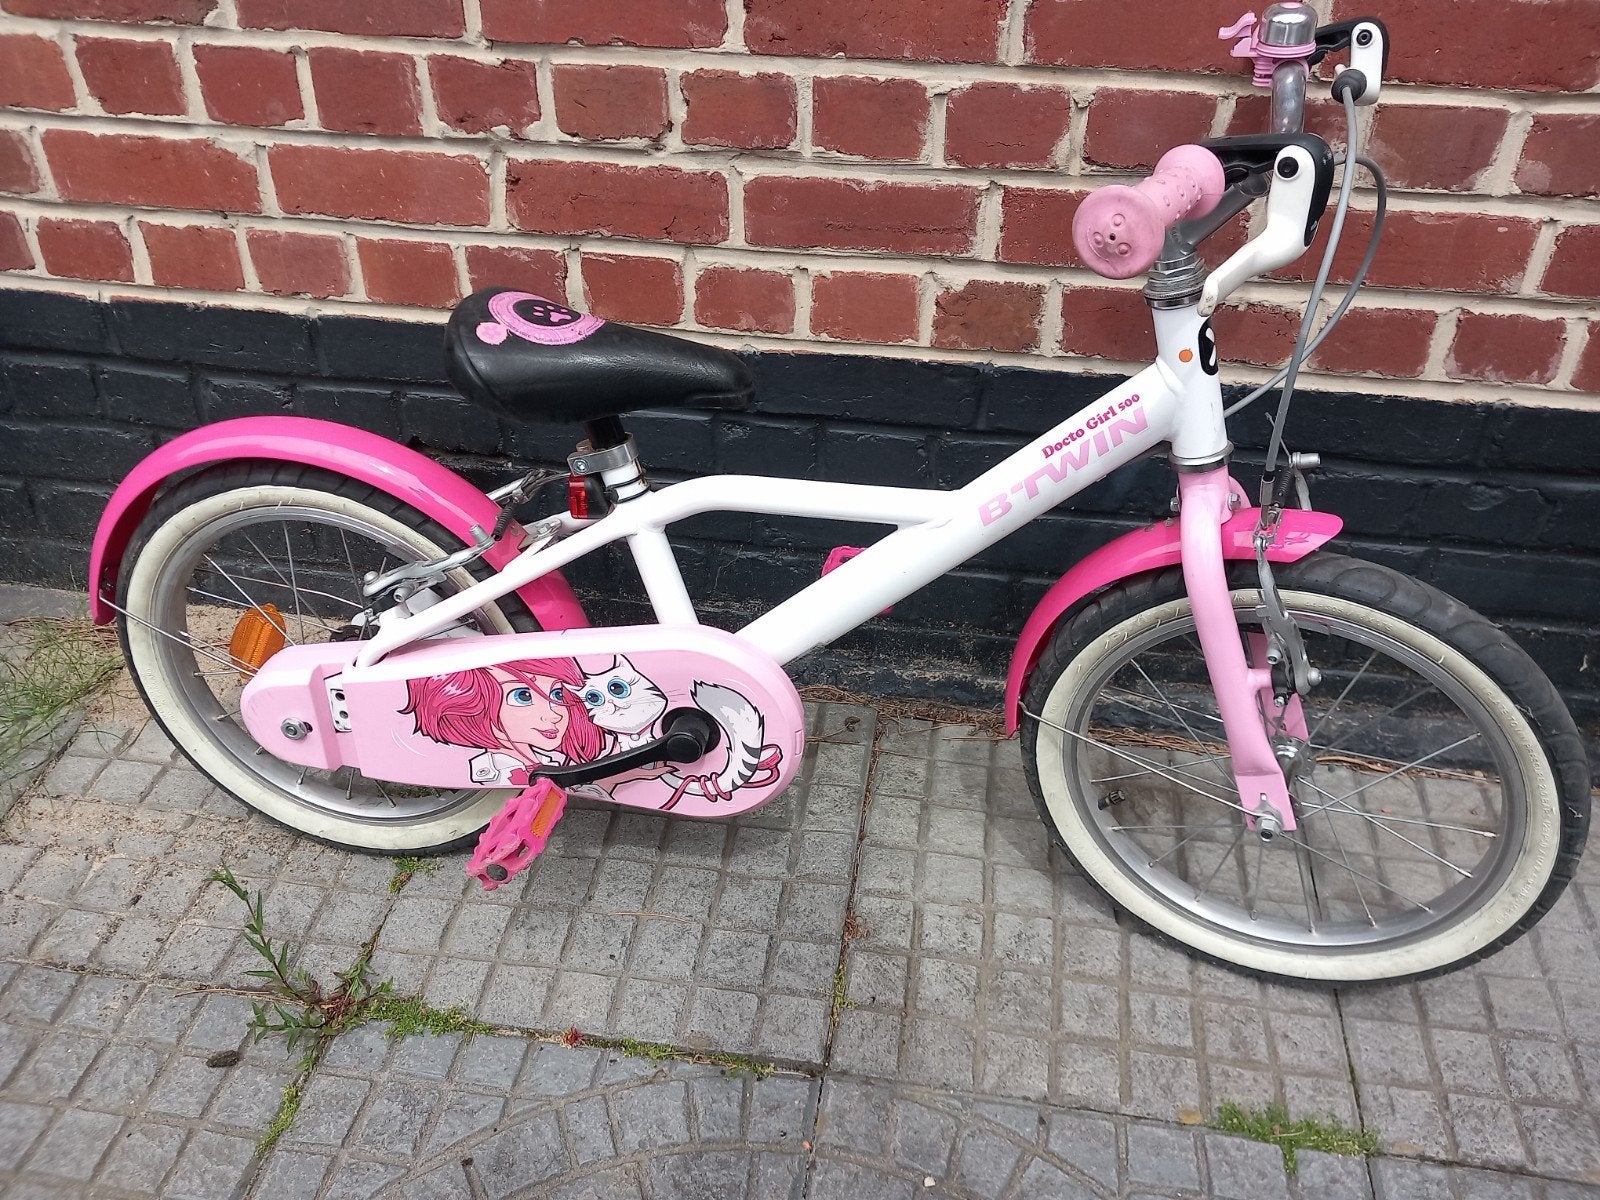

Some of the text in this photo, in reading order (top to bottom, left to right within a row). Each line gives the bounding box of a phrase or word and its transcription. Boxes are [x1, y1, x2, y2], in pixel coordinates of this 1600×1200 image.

[1041, 393, 1140, 459] Docto Girl 500
